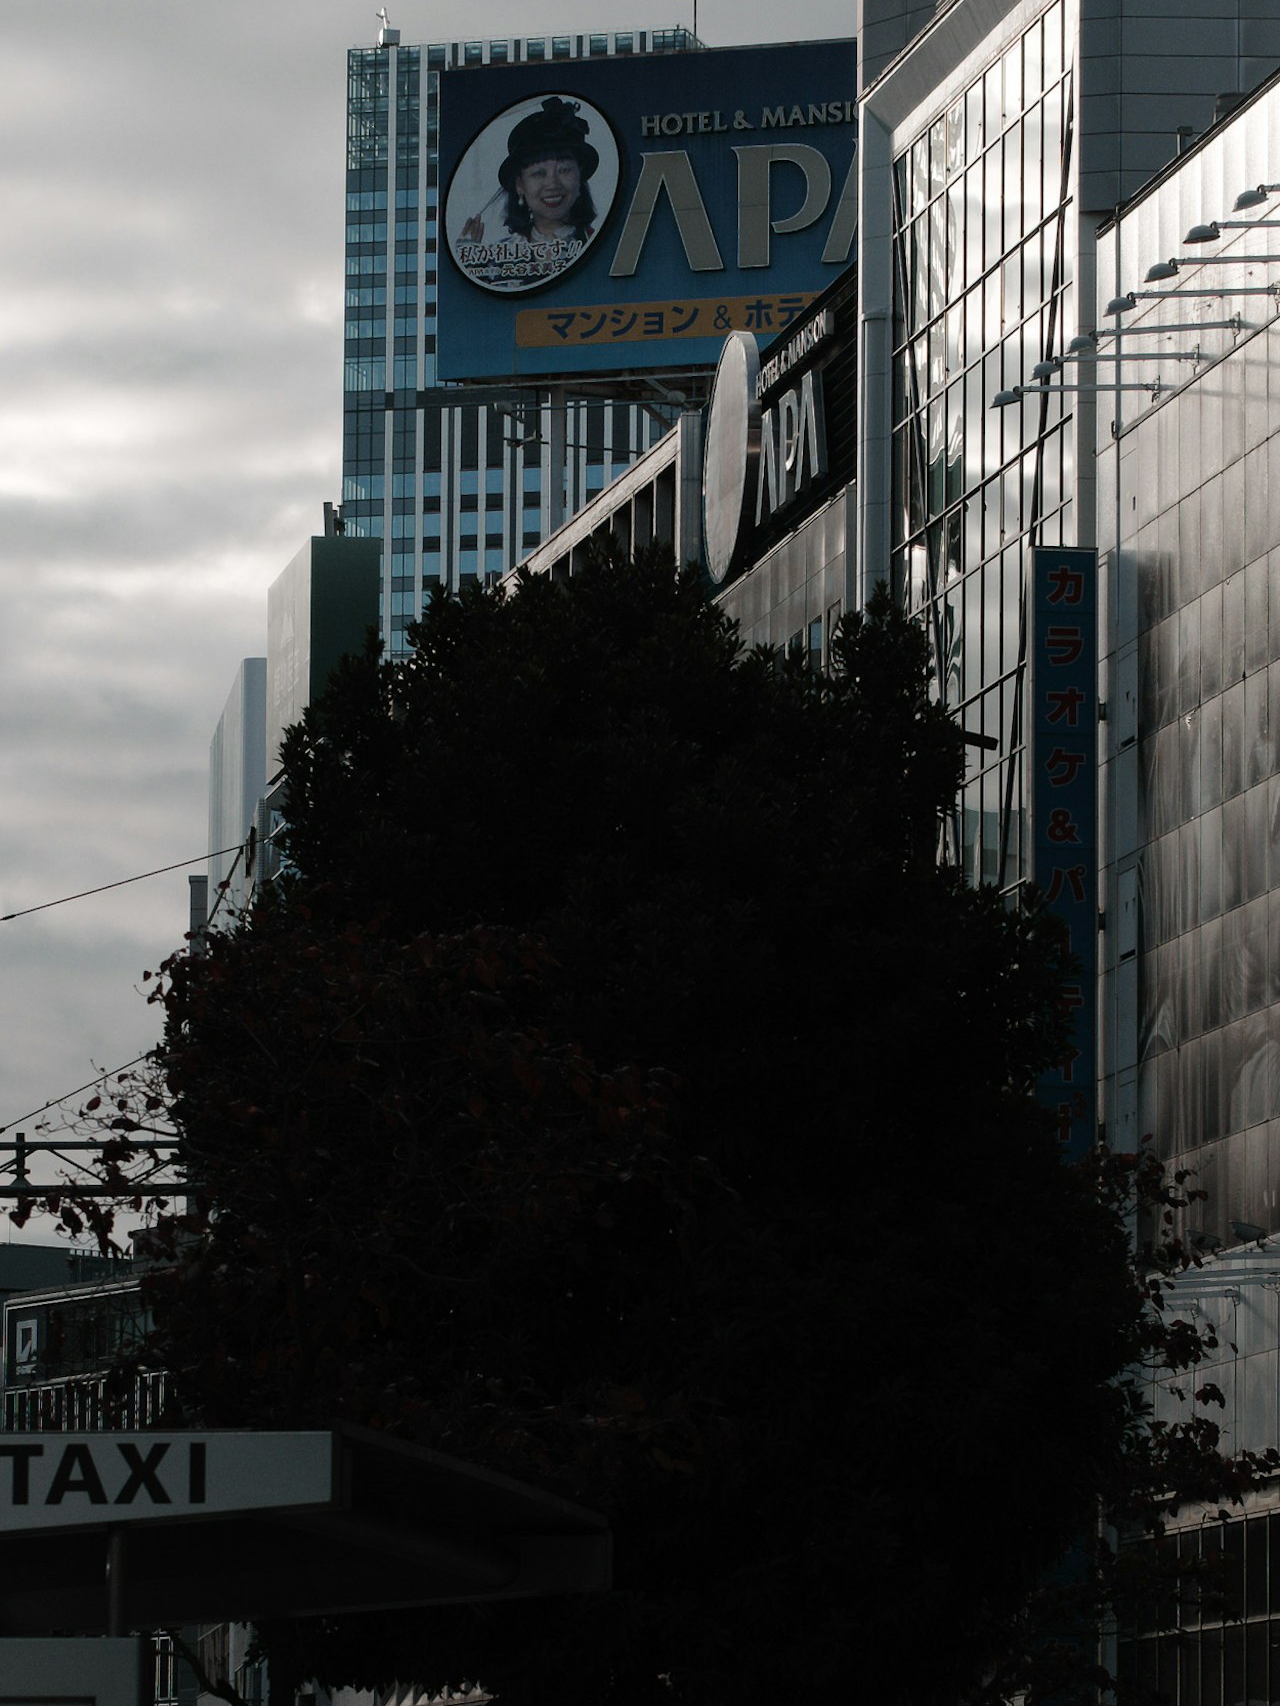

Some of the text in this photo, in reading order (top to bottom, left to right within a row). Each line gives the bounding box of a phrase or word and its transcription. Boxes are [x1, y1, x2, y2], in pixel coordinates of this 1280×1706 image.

[641, 101, 859, 137] HOTEL & MANSI
[547, 296, 816, 339] マンション & ホテ
[754, 368, 827, 528] APA
[0, 1442, 206, 1505] TAXI
